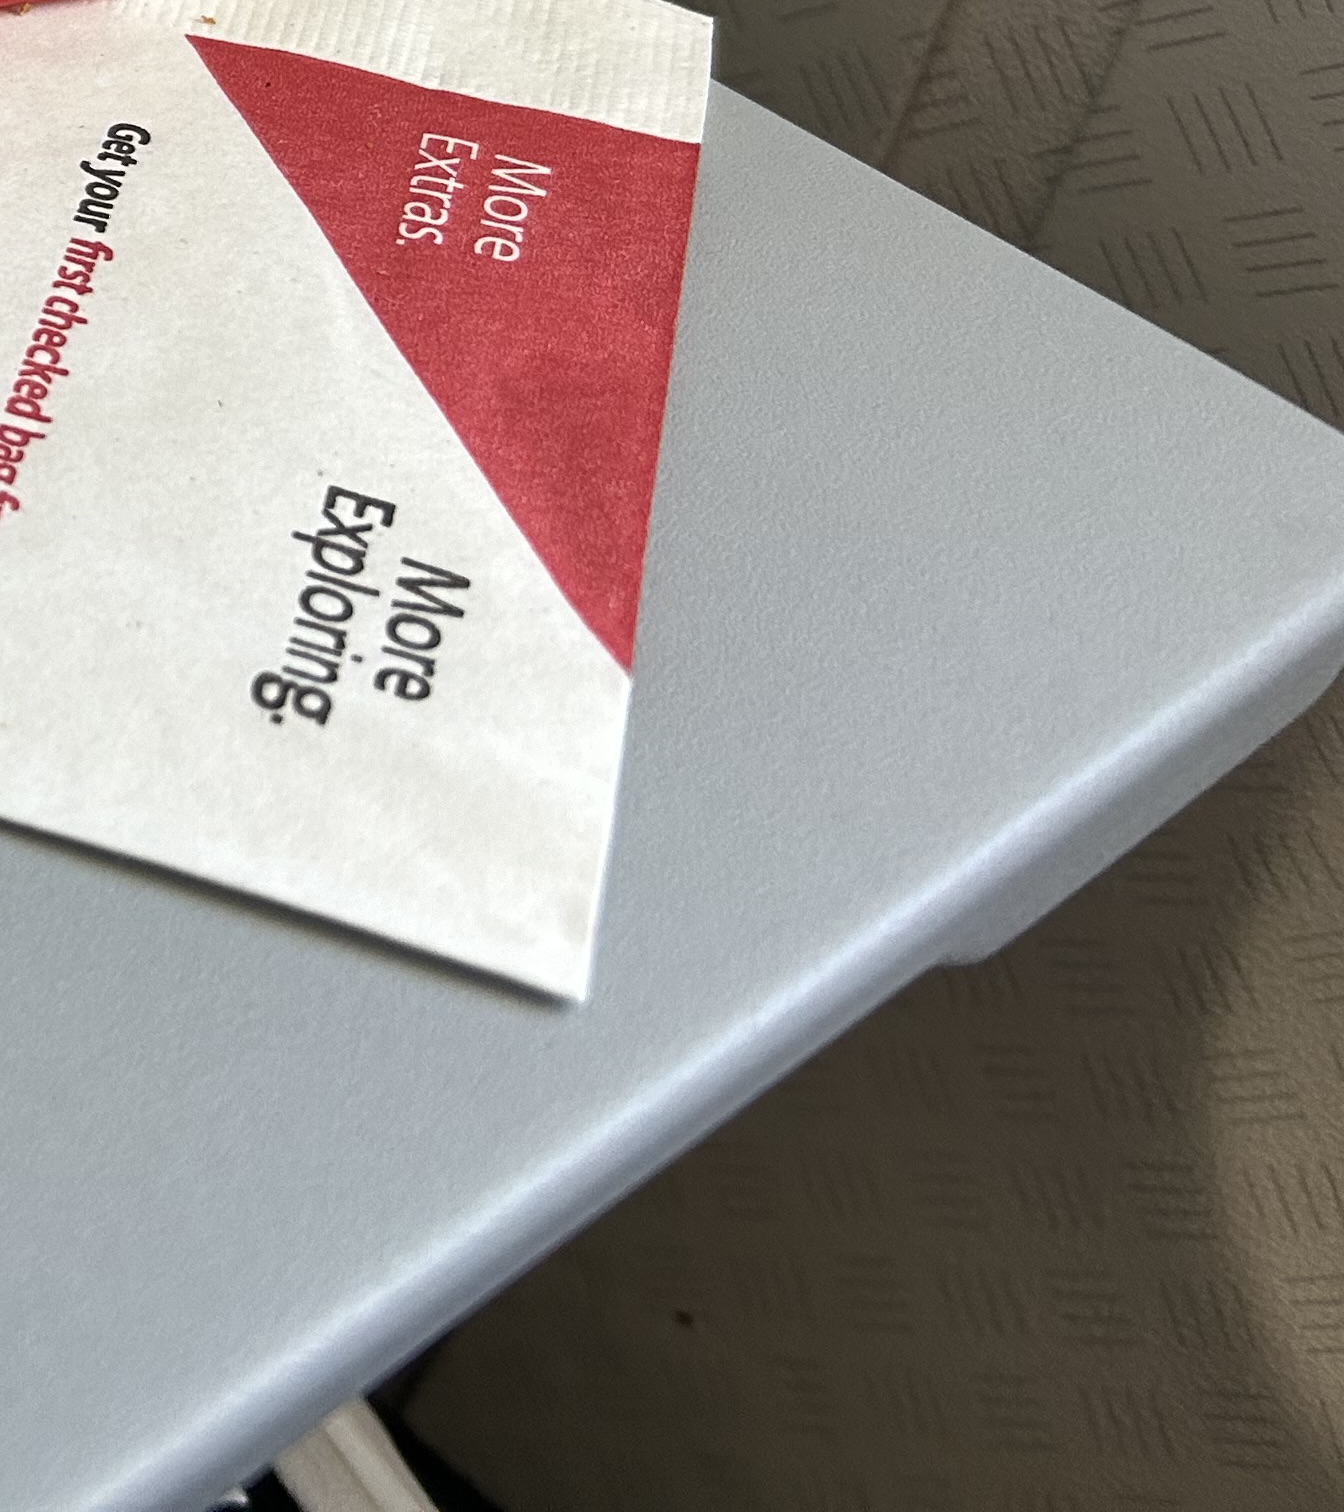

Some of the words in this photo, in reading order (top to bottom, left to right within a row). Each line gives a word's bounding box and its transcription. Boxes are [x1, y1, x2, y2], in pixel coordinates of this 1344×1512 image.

[73, 160, 126, 234] your
[97, 122, 152, 167] Get
[398, 131, 479, 247] Extras.
[474, 152, 552, 264] More
[52, 237, 114, 295] first
[4, 294, 89, 424] checked
[249, 485, 396, 727] Exploring.
[374, 557, 471, 703] More
